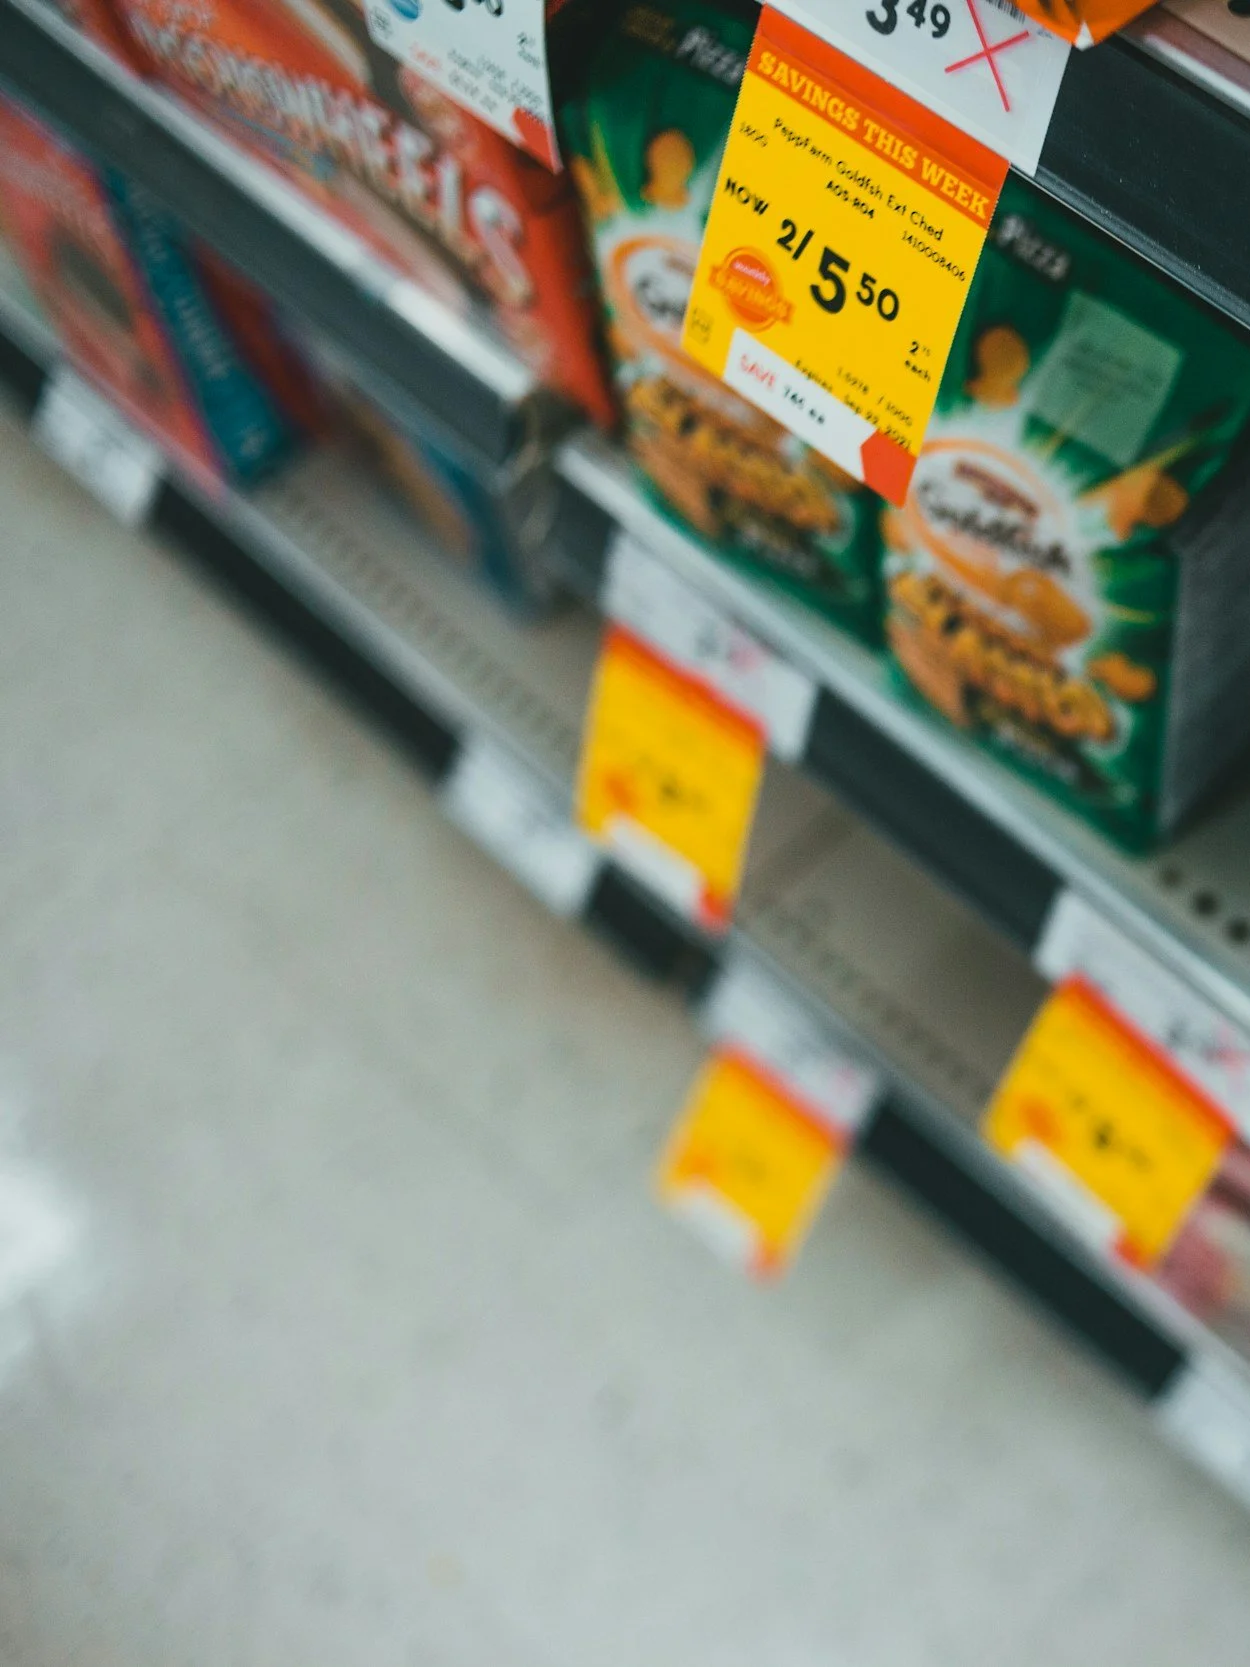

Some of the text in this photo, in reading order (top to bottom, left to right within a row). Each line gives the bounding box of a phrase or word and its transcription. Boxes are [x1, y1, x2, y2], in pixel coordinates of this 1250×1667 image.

[757, 51, 990, 220] SAVINGS THIS WEEK
[724, 177, 769, 216] NOW
[910, 210, 944, 241] Ched
